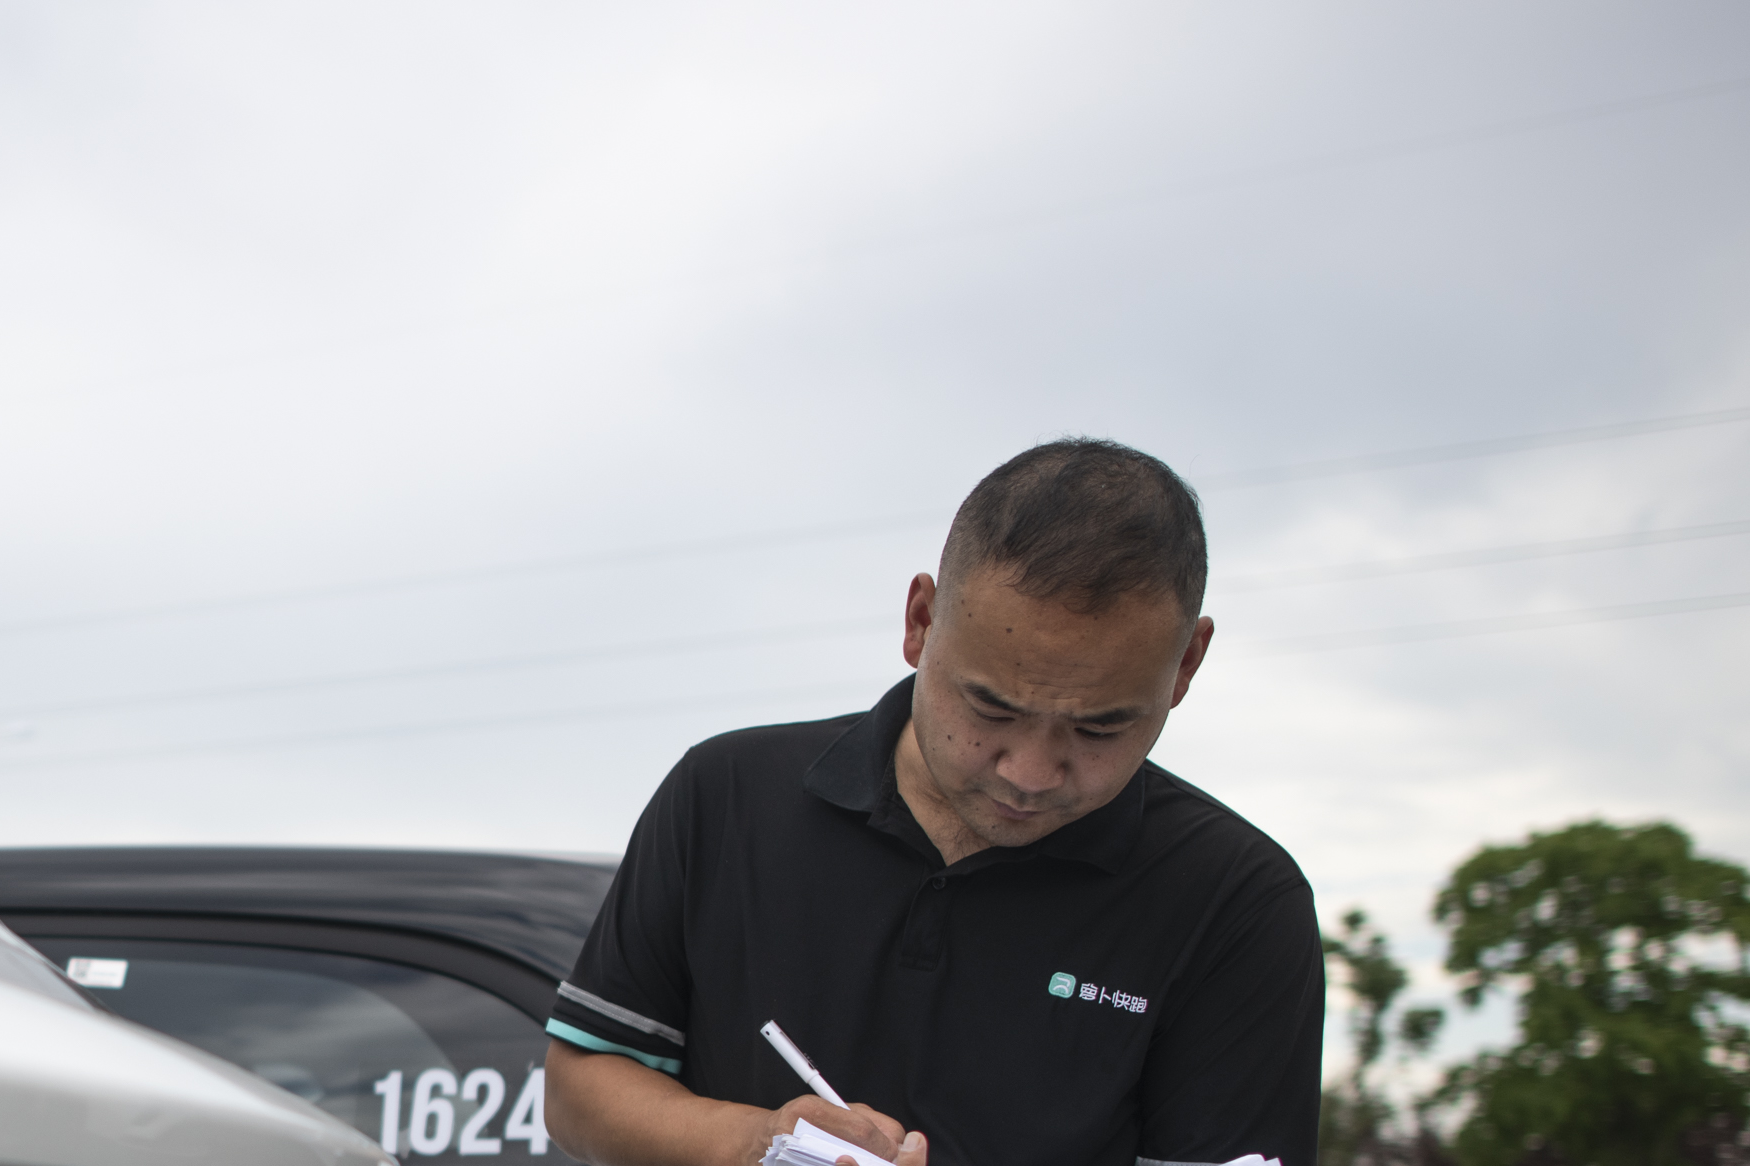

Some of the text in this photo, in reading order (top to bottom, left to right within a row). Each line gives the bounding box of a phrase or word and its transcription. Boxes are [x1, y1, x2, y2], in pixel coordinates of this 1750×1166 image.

[1078, 982, 1148, 1014] 萝卜快跑
[372, 1067, 552, 1157] 1624
